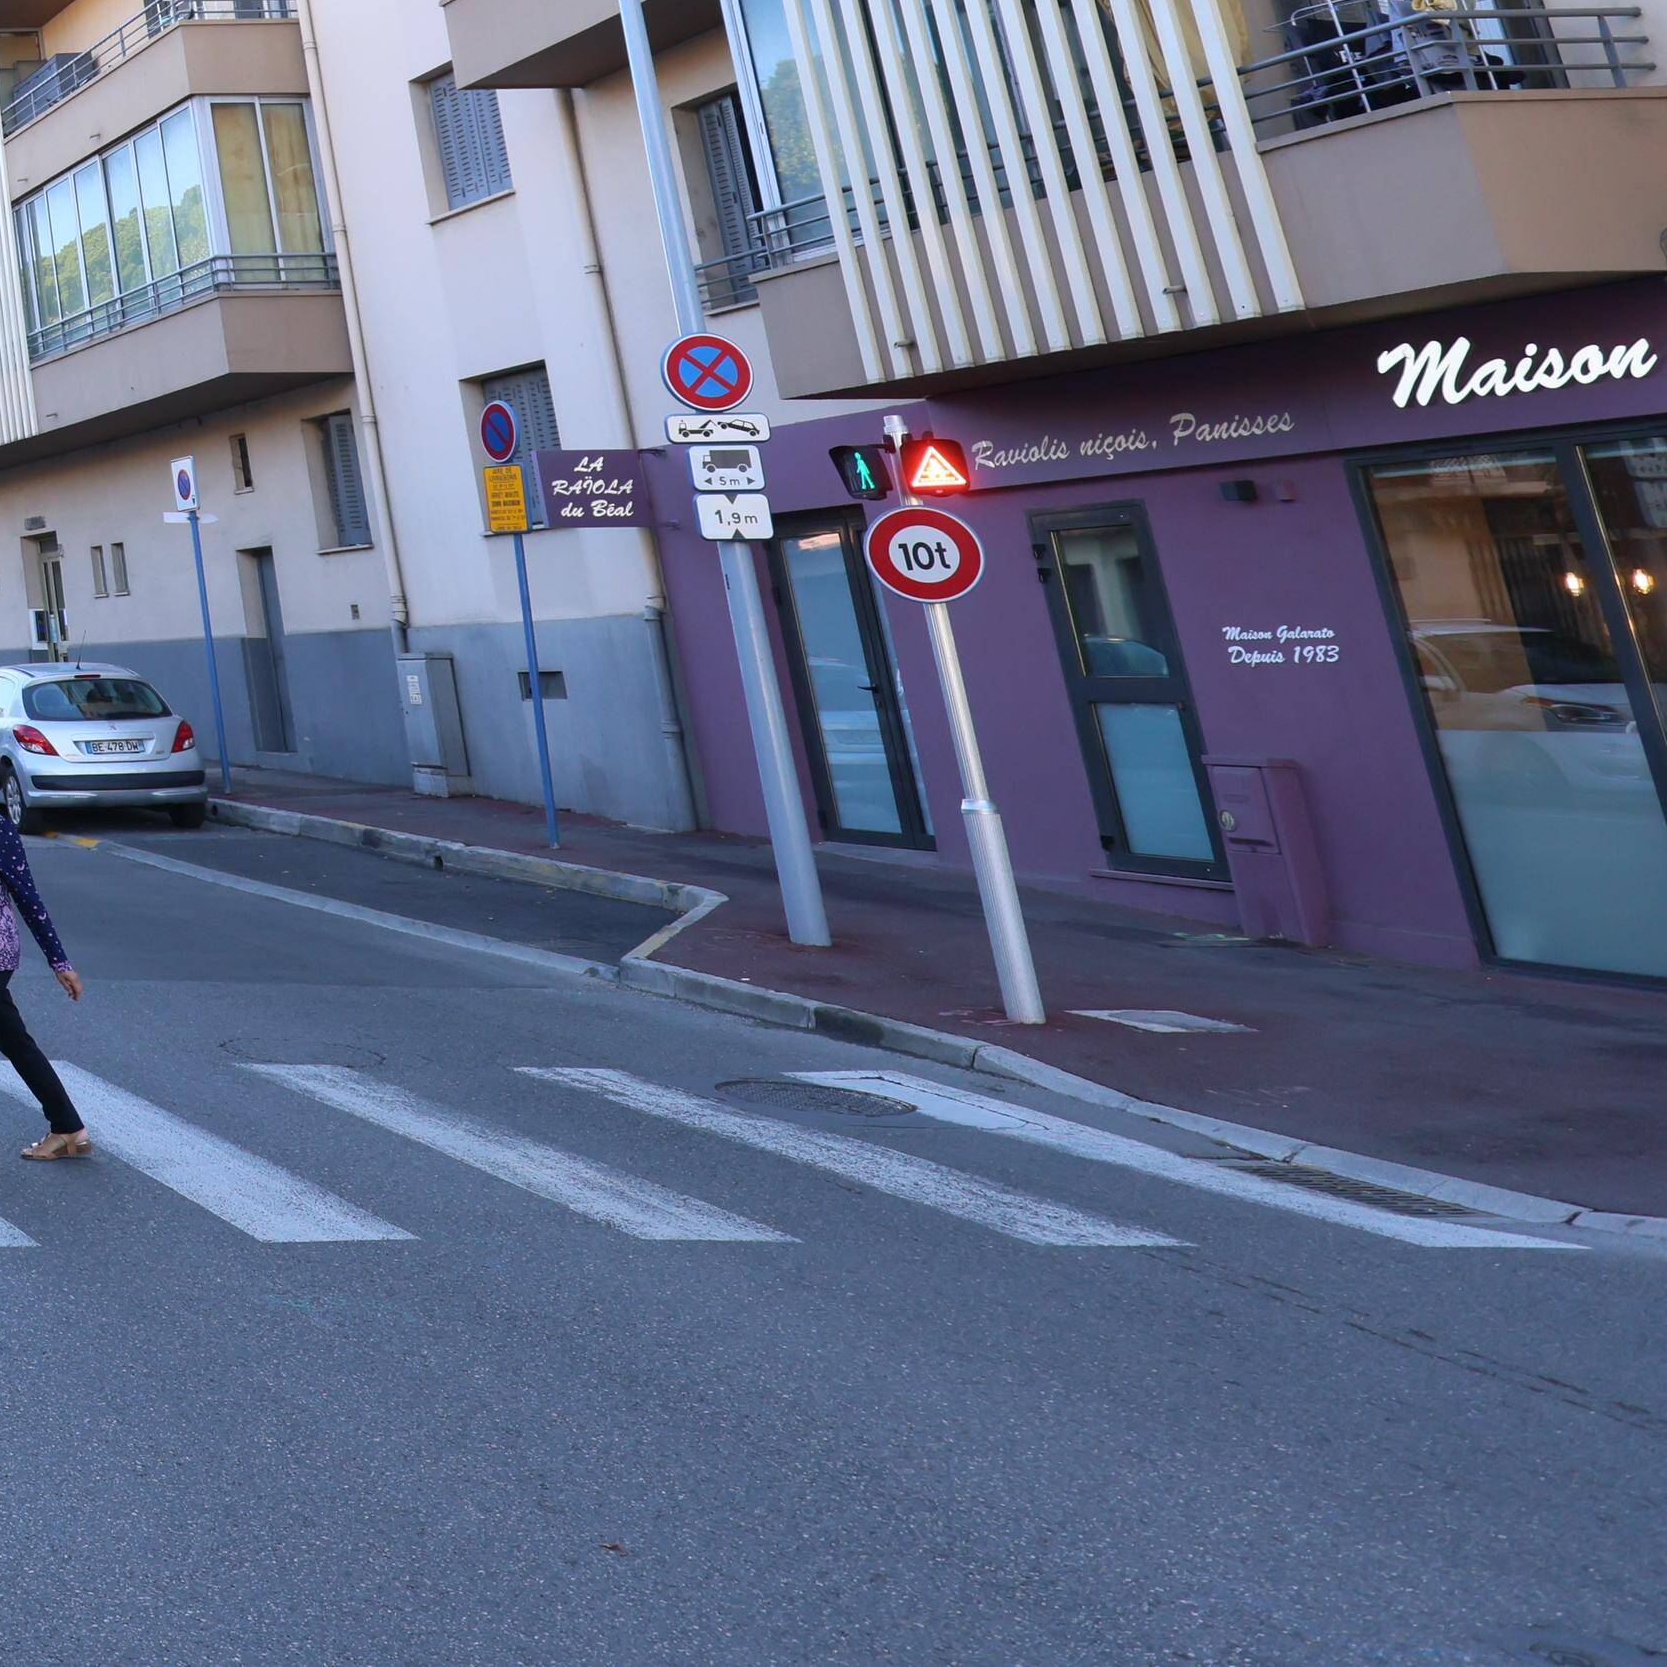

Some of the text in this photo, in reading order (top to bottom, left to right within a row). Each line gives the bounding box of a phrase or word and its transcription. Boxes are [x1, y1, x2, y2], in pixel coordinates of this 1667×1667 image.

[1376, 336, 1659, 409] Maison
[971, 436, 1071, 471] Raviolis
[1169, 411, 1296, 447] Panisses
[573, 456, 605, 473] LA
[551, 475, 634, 496] RAÏOLA
[560, 499, 634, 518] du Béal
[898, 541, 952, 572] 10t
[1221, 625, 1336, 644] Maison Galarato
[1227, 644, 1340, 668] Depuis 1983
